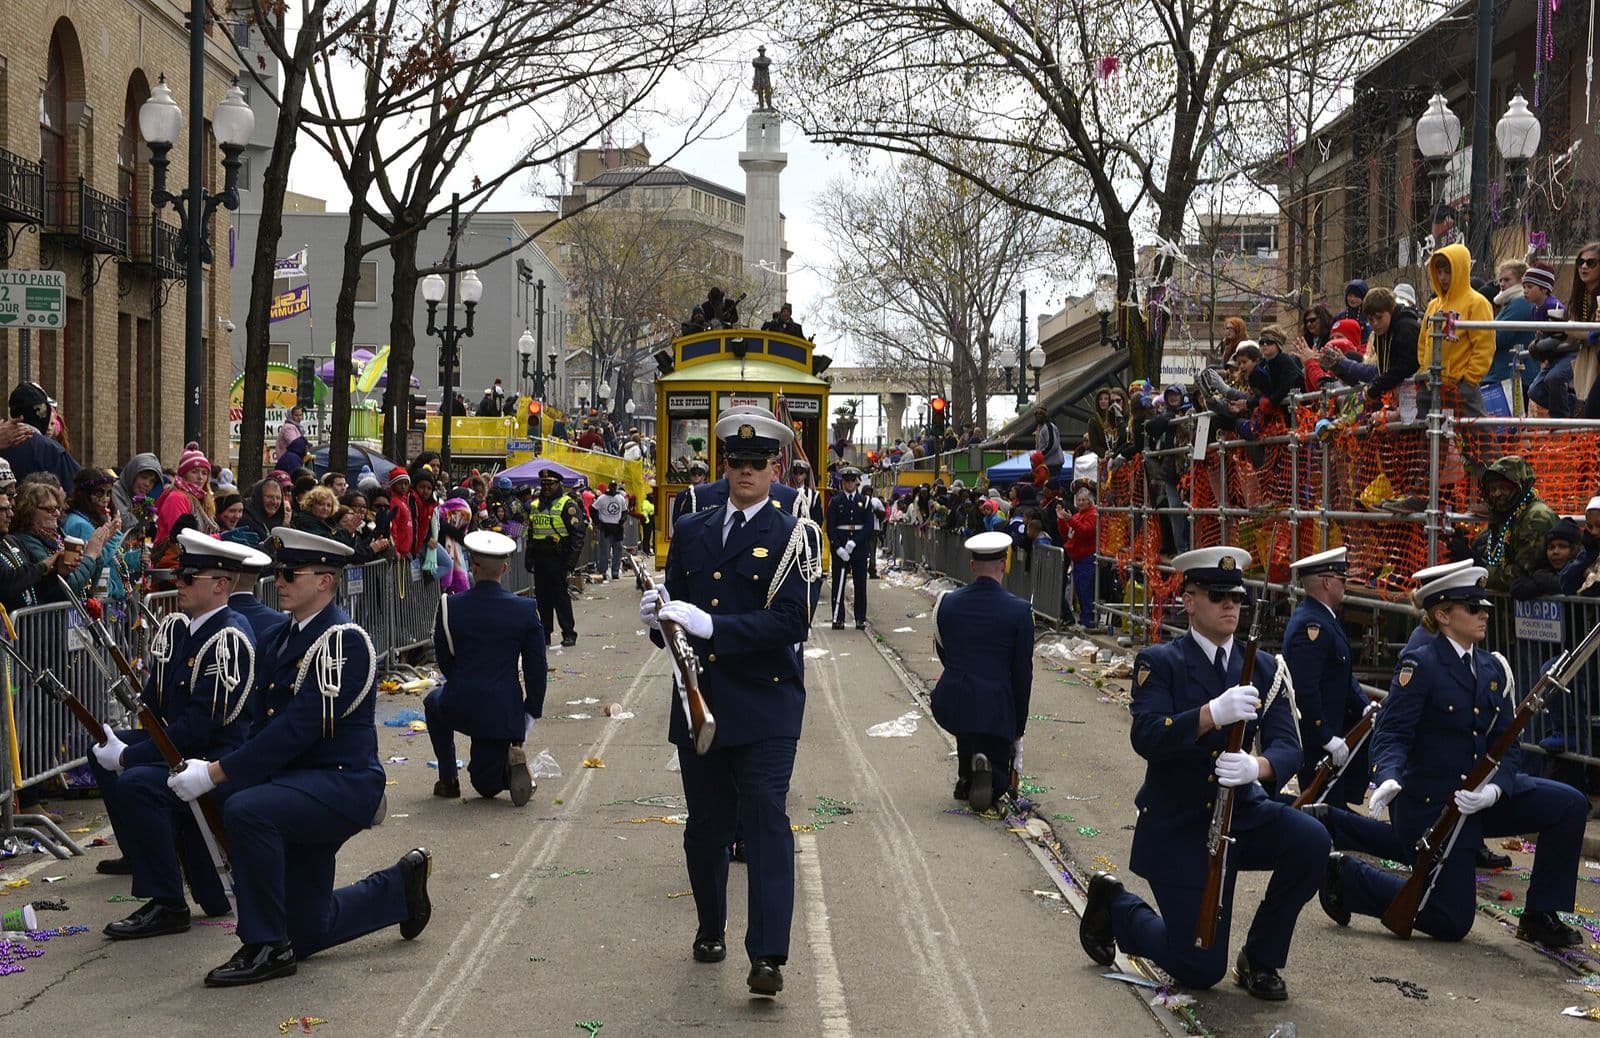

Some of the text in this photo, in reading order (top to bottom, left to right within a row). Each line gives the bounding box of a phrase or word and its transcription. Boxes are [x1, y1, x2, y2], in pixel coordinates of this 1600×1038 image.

[12, 273, 26, 284] TO
[30, 273, 60, 286] PARK
[1, 286, 10, 301] 2
[1160, 364, 1201, 376] chlumberger
[787, 400, 817, 409] ESIRE
